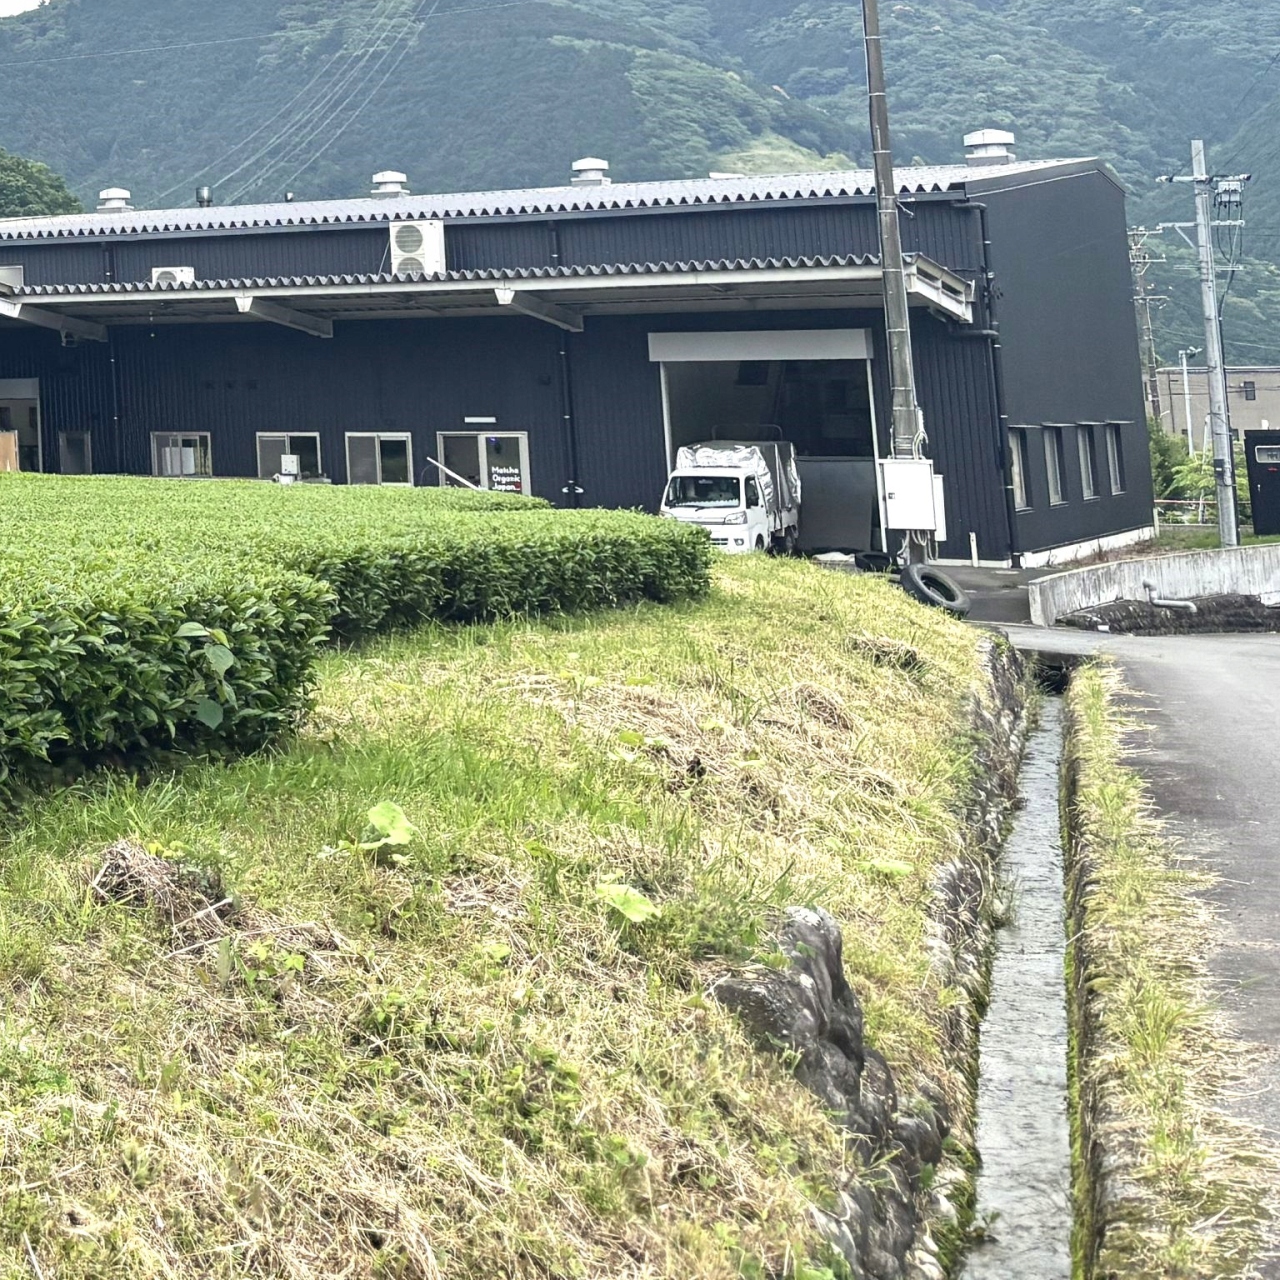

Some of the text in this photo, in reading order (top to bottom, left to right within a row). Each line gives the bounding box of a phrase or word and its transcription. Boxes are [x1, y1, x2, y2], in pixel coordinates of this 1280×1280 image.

[491, 466, 519, 474] Matcha
[492, 474, 520, 483] Organic
[492, 482, 516, 491] Japan
